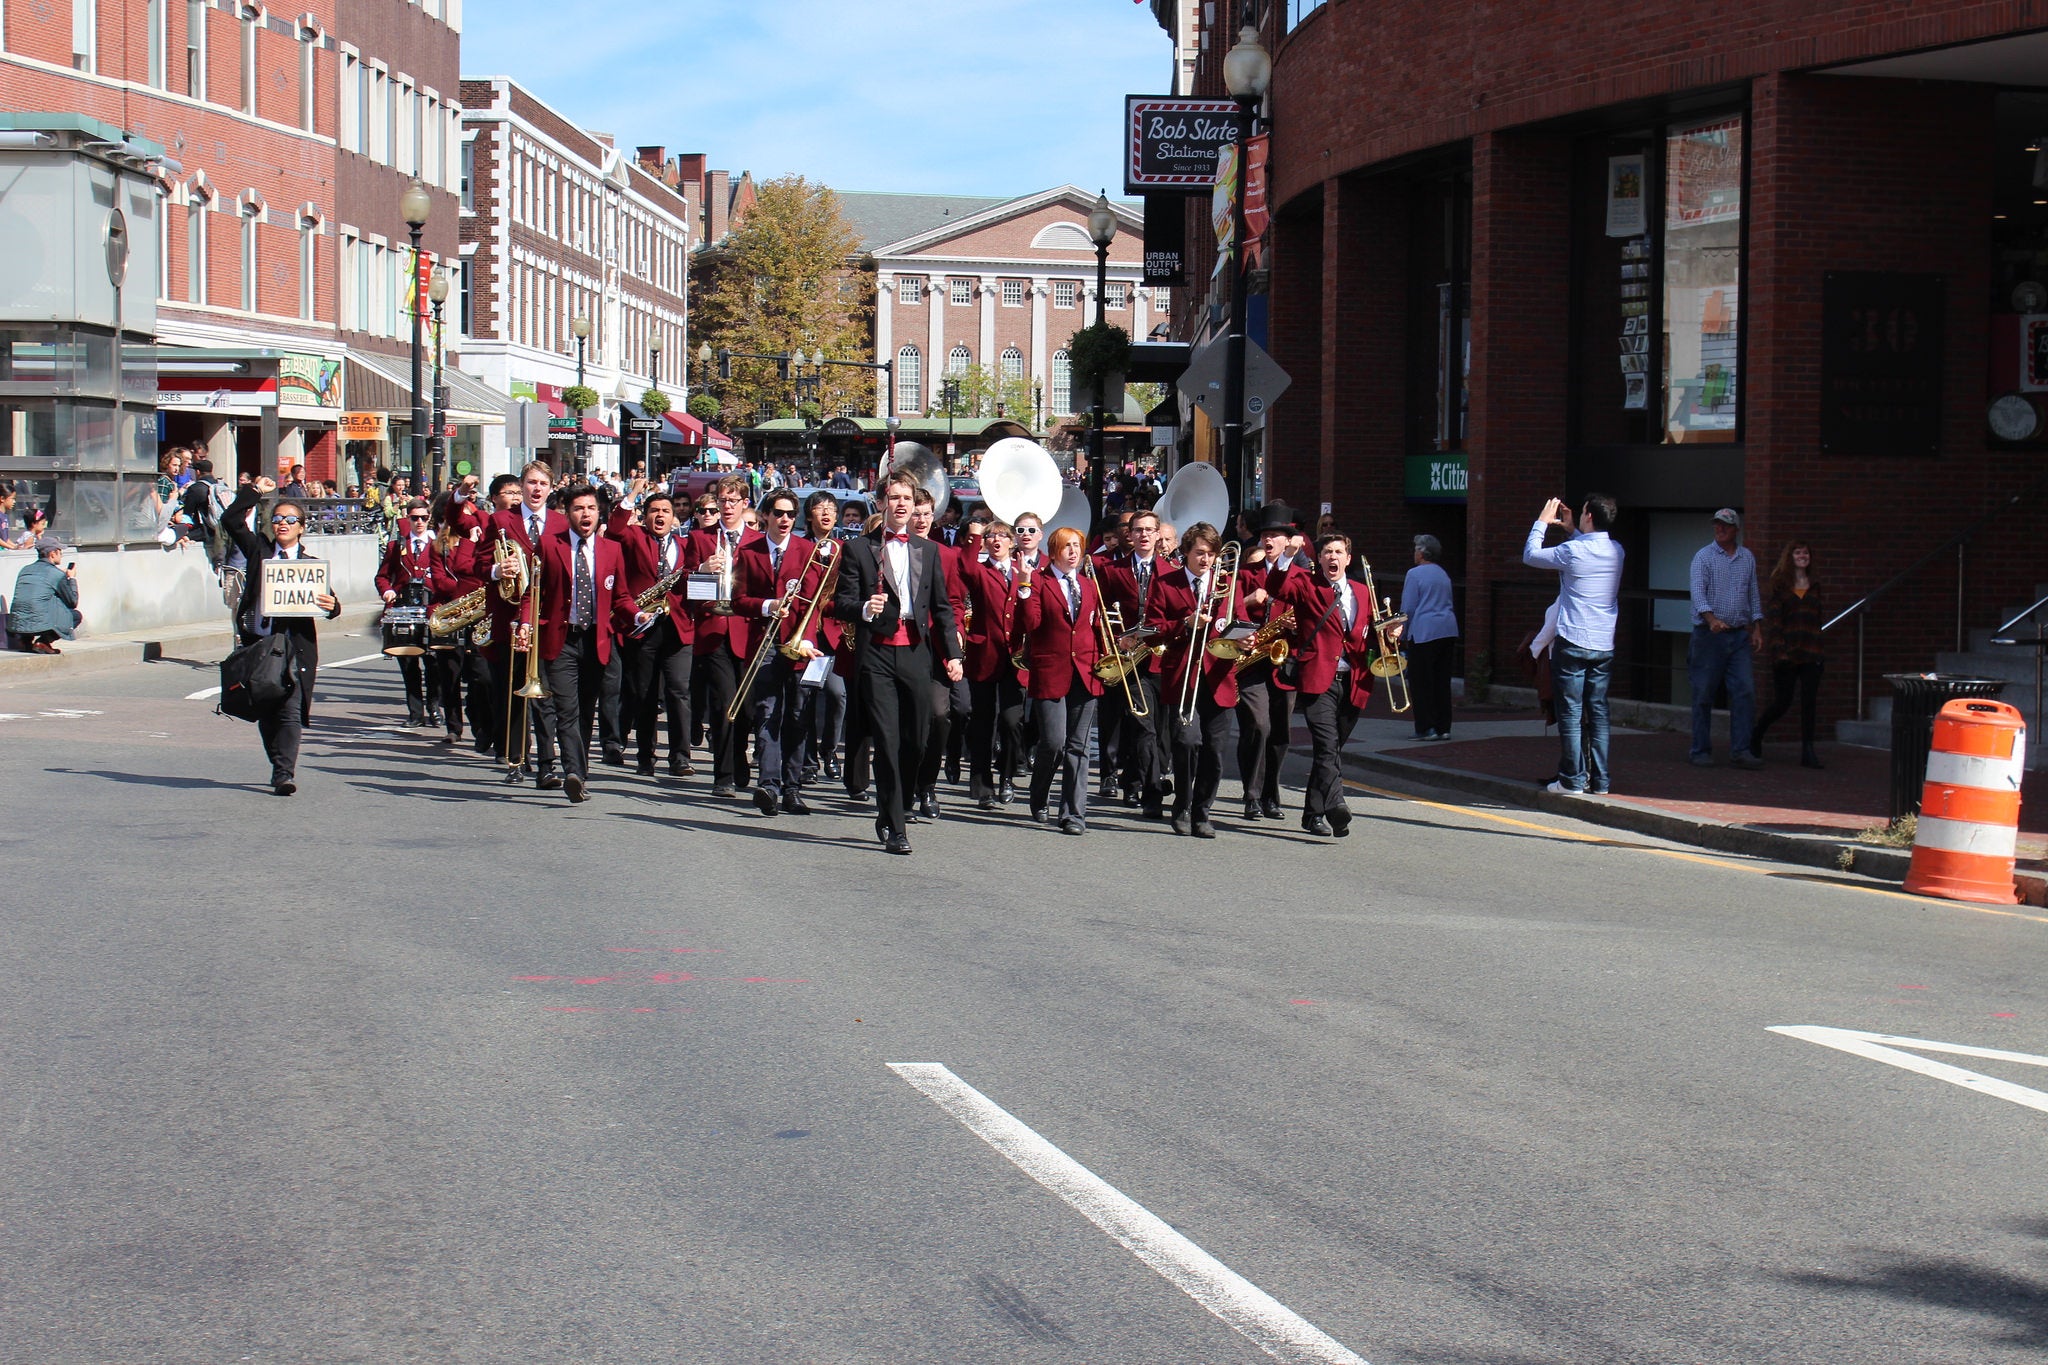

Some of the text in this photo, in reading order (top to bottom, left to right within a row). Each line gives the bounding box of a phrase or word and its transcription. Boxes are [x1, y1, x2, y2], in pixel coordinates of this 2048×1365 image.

[1148, 117, 1239, 140] Bob Slate
[1156, 142, 1218, 159] Statione
[1146, 252, 1178, 260] URBAN
[1146, 268, 1170, 276] TERS
[157, 393, 182, 402] USES
[339, 416, 383, 426] BEAT
[548, 432, 577, 440] ocolates
[266, 568, 325, 584] HARVAR
[273, 589, 316, 605] DIANA
